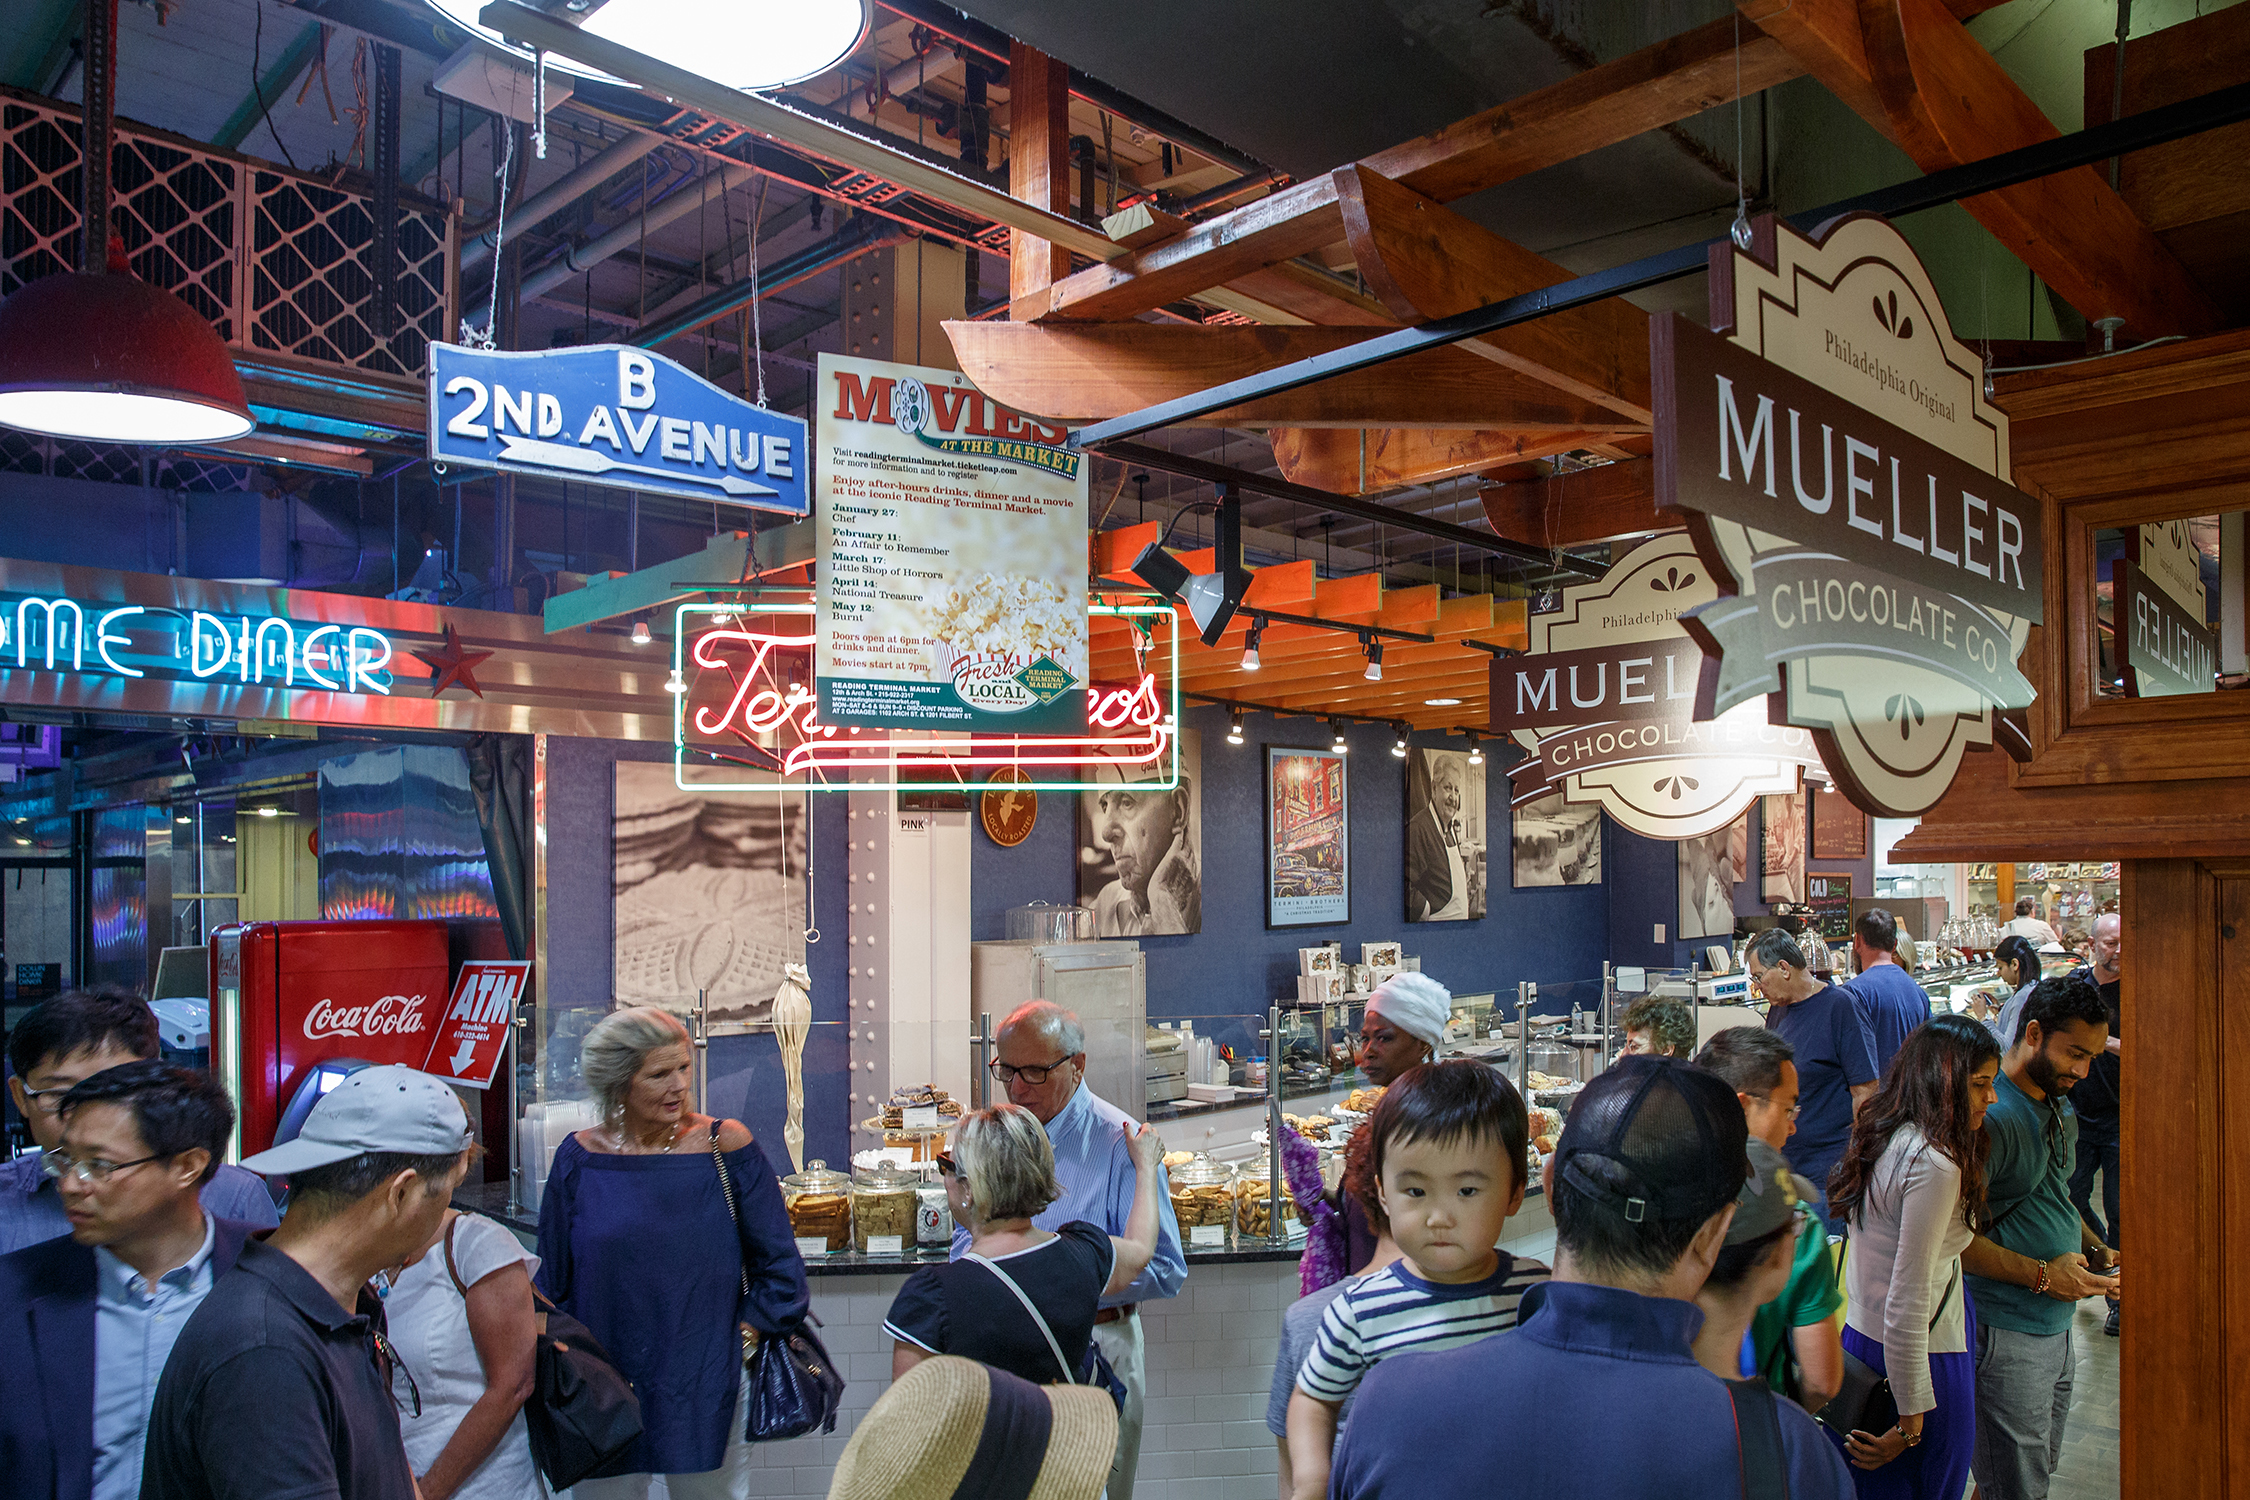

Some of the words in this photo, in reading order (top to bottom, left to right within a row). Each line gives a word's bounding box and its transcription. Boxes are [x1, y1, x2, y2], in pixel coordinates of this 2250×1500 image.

[618, 350, 656, 410] B
[1824, 329, 1906, 396] Philadelphia
[1909, 379, 1955, 424] Original
[444, 376, 563, 439] 2ND
[578, 404, 794, 478] AVENUE
[833, 447, 852, 457] Visit
[854, 449, 1017, 475] readingterminalmarket.ticketleap.com
[940, 441, 957, 450] AT
[961, 441, 993, 453] THE
[997, 442, 1078, 473] MARKET
[833, 457, 845, 465] for
[847, 460, 868, 468] more
[870, 461, 918, 474] information
[920, 468, 935, 476] and
[947, 471, 978, 480] register
[1715, 373, 2026, 591] MUELLER
[833, 475, 865, 488] Enjoy
[868, 479, 930, 493] after-hours
[932, 484, 971, 498] drinks,
[974, 490, 1009, 501] dinner
[1011, 495, 1031, 503] and
[1043, 497, 1074, 508] movie
[833, 487, 844, 495] at
[848, 488, 866, 497] the
[869, 490, 901, 501] iconic
[904, 493, 950, 508] Reading
[953, 498, 1002, 511] Terminal
[1005, 503, 1046, 515] Market.
[832, 503, 879, 517] January
[881, 509, 898, 517] 27:
[832, 514, 856, 523] Chef
[832, 528, 883, 542] February
[887, 533, 901, 541] 11:
[832, 538, 847, 547] An
[850, 540, 881, 550] Affair
[884, 543, 894, 551] to
[897, 544, 950, 556] Remember
[832, 552, 868, 563] March
[872, 556, 886, 564] 17:
[832, 563, 860, 573] Little
[862, 566, 887, 577] Shop
[890, 568, 901, 576] of
[903, 569, 943, 579] Horrors
[832, 577, 859, 588] April
[863, 580, 878, 588] 14:
[832, 587, 876, 598] National
[879, 591, 924, 602] Treasure
[832, 601, 856, 612] May
[860, 604, 874, 612] 12:
[832, 612, 864, 621] Burnt
[1771, 578, 1956, 650] CHOCOLATE
[1965, 625, 2002, 683] CO.
[832, 631, 860, 641] Doors
[863, 635, 885, 644] open
[900, 636, 920, 646] 6pm
[922, 637, 936, 645] for
[0, 597, 145, 677] ME
[191, 610, 391, 696] DINER
[832, 642, 864, 652] drinks
[867, 644, 884, 653] and
[887, 645, 920, 655] dinner.
[832, 658, 867, 667] Movies
[869, 661, 893, 669] start
[950, 652, 1016, 691] Fresh
[1025, 675, 1066, 683] TERMINAL
[1028, 669, 1063, 677] READING
[831, 682, 867, 690] READING
[869, 684, 908, 692] TERMINAL
[968, 684, 1026, 699] LOCAL
[1029, 681, 1063, 689] MARKET
[940, 711, 964, 719] FILBERT
[1551, 721, 1743, 766] CHOCOLATE
[901, 820, 924, 829] PINK
[988, 813, 1009, 840] LOCALLY
[1009, 815, 1033, 841] ROASTED
[449, 974, 518, 1024] ATM
[303, 994, 427, 1040] Coca-Cola
[461, 1022, 488, 1032] Machine
